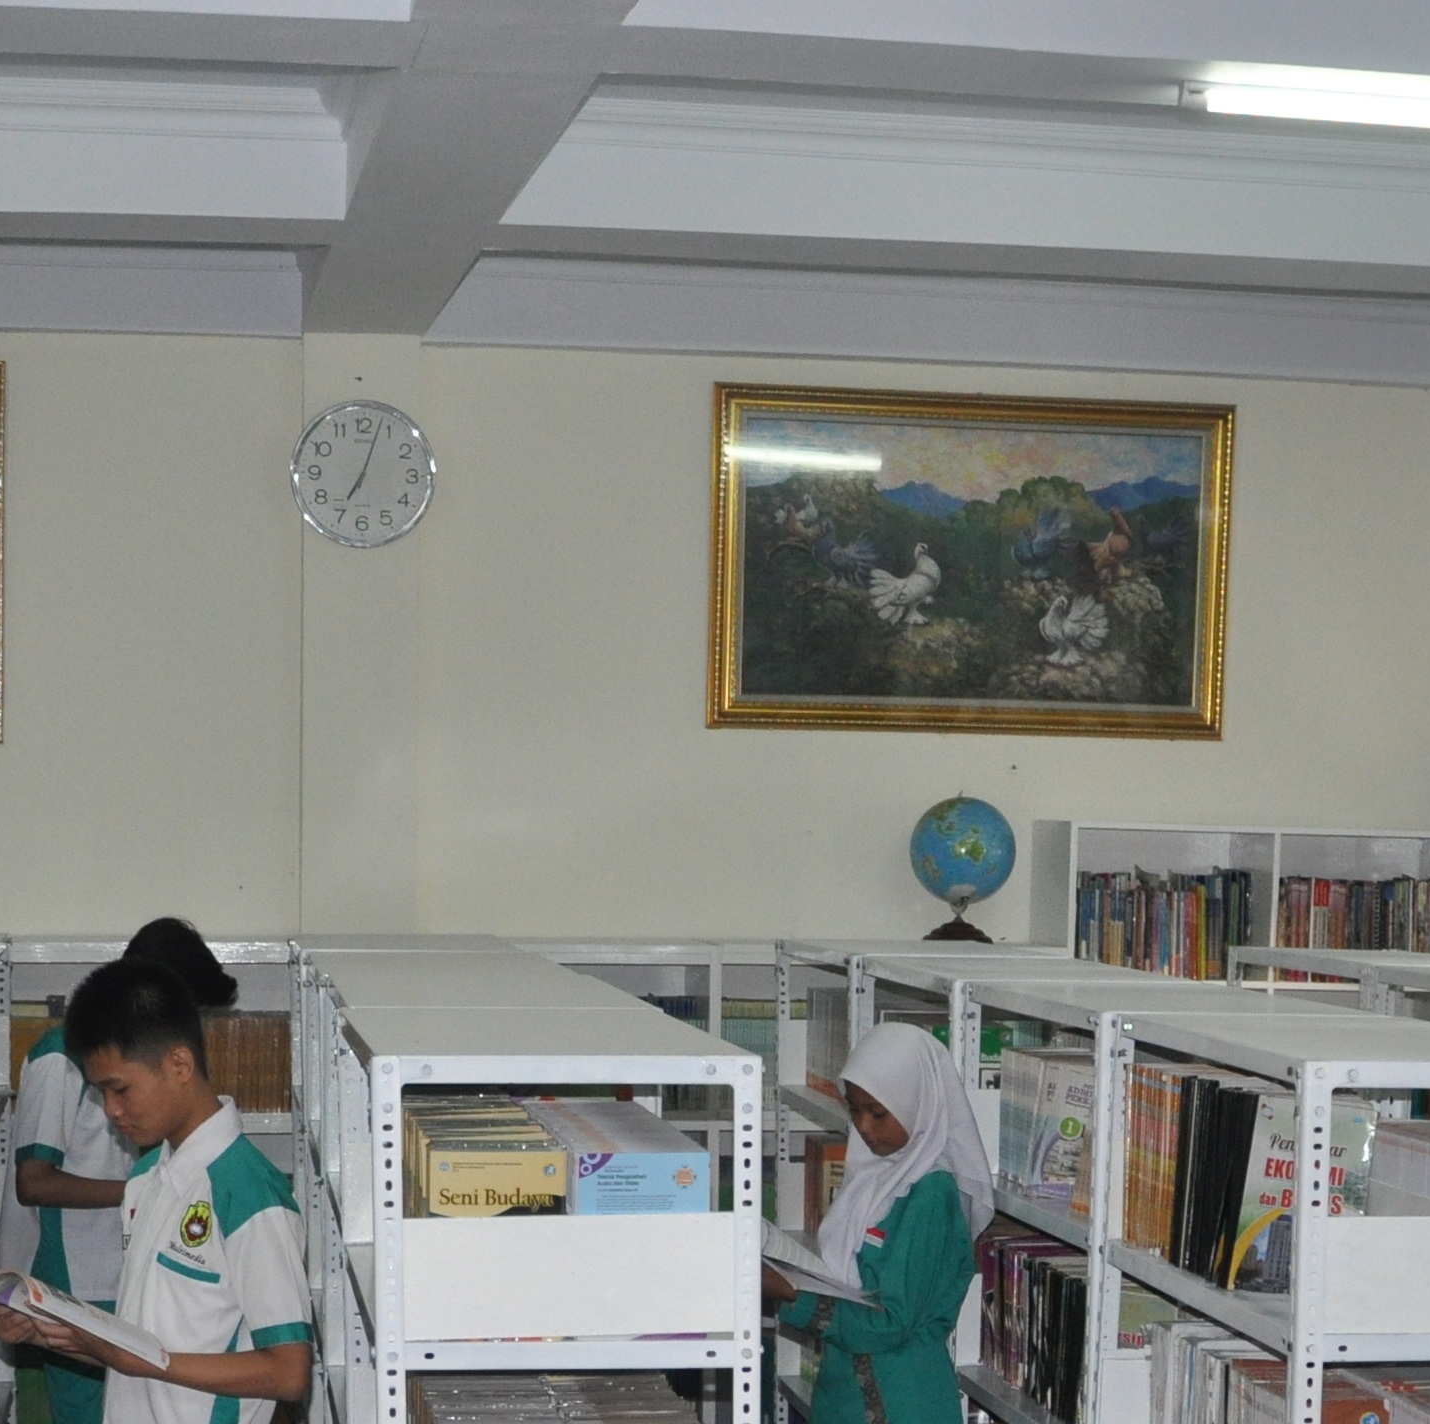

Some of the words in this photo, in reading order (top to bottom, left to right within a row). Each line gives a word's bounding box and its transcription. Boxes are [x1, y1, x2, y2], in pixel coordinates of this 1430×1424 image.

[334, 423, 346, 438] 11
[355, 418, 372, 434] 12
[386, 425, 391, 439] 1
[314, 441, 332, 457] 10
[399, 443, 412, 459] 2
[308, 465, 321, 480] 9
[405, 468, 419, 484] 3
[314, 489, 328, 505] 8
[397, 493, 409, 507] 4
[334, 509, 346, 524] 7
[355, 516, 369, 531] 6
[379, 510, 393, 526] 5
[439, 1188, 479, 1206] Seni
[484, 1187, 555, 1213] Budaya
[1259, 1192, 1277, 1206] dan
